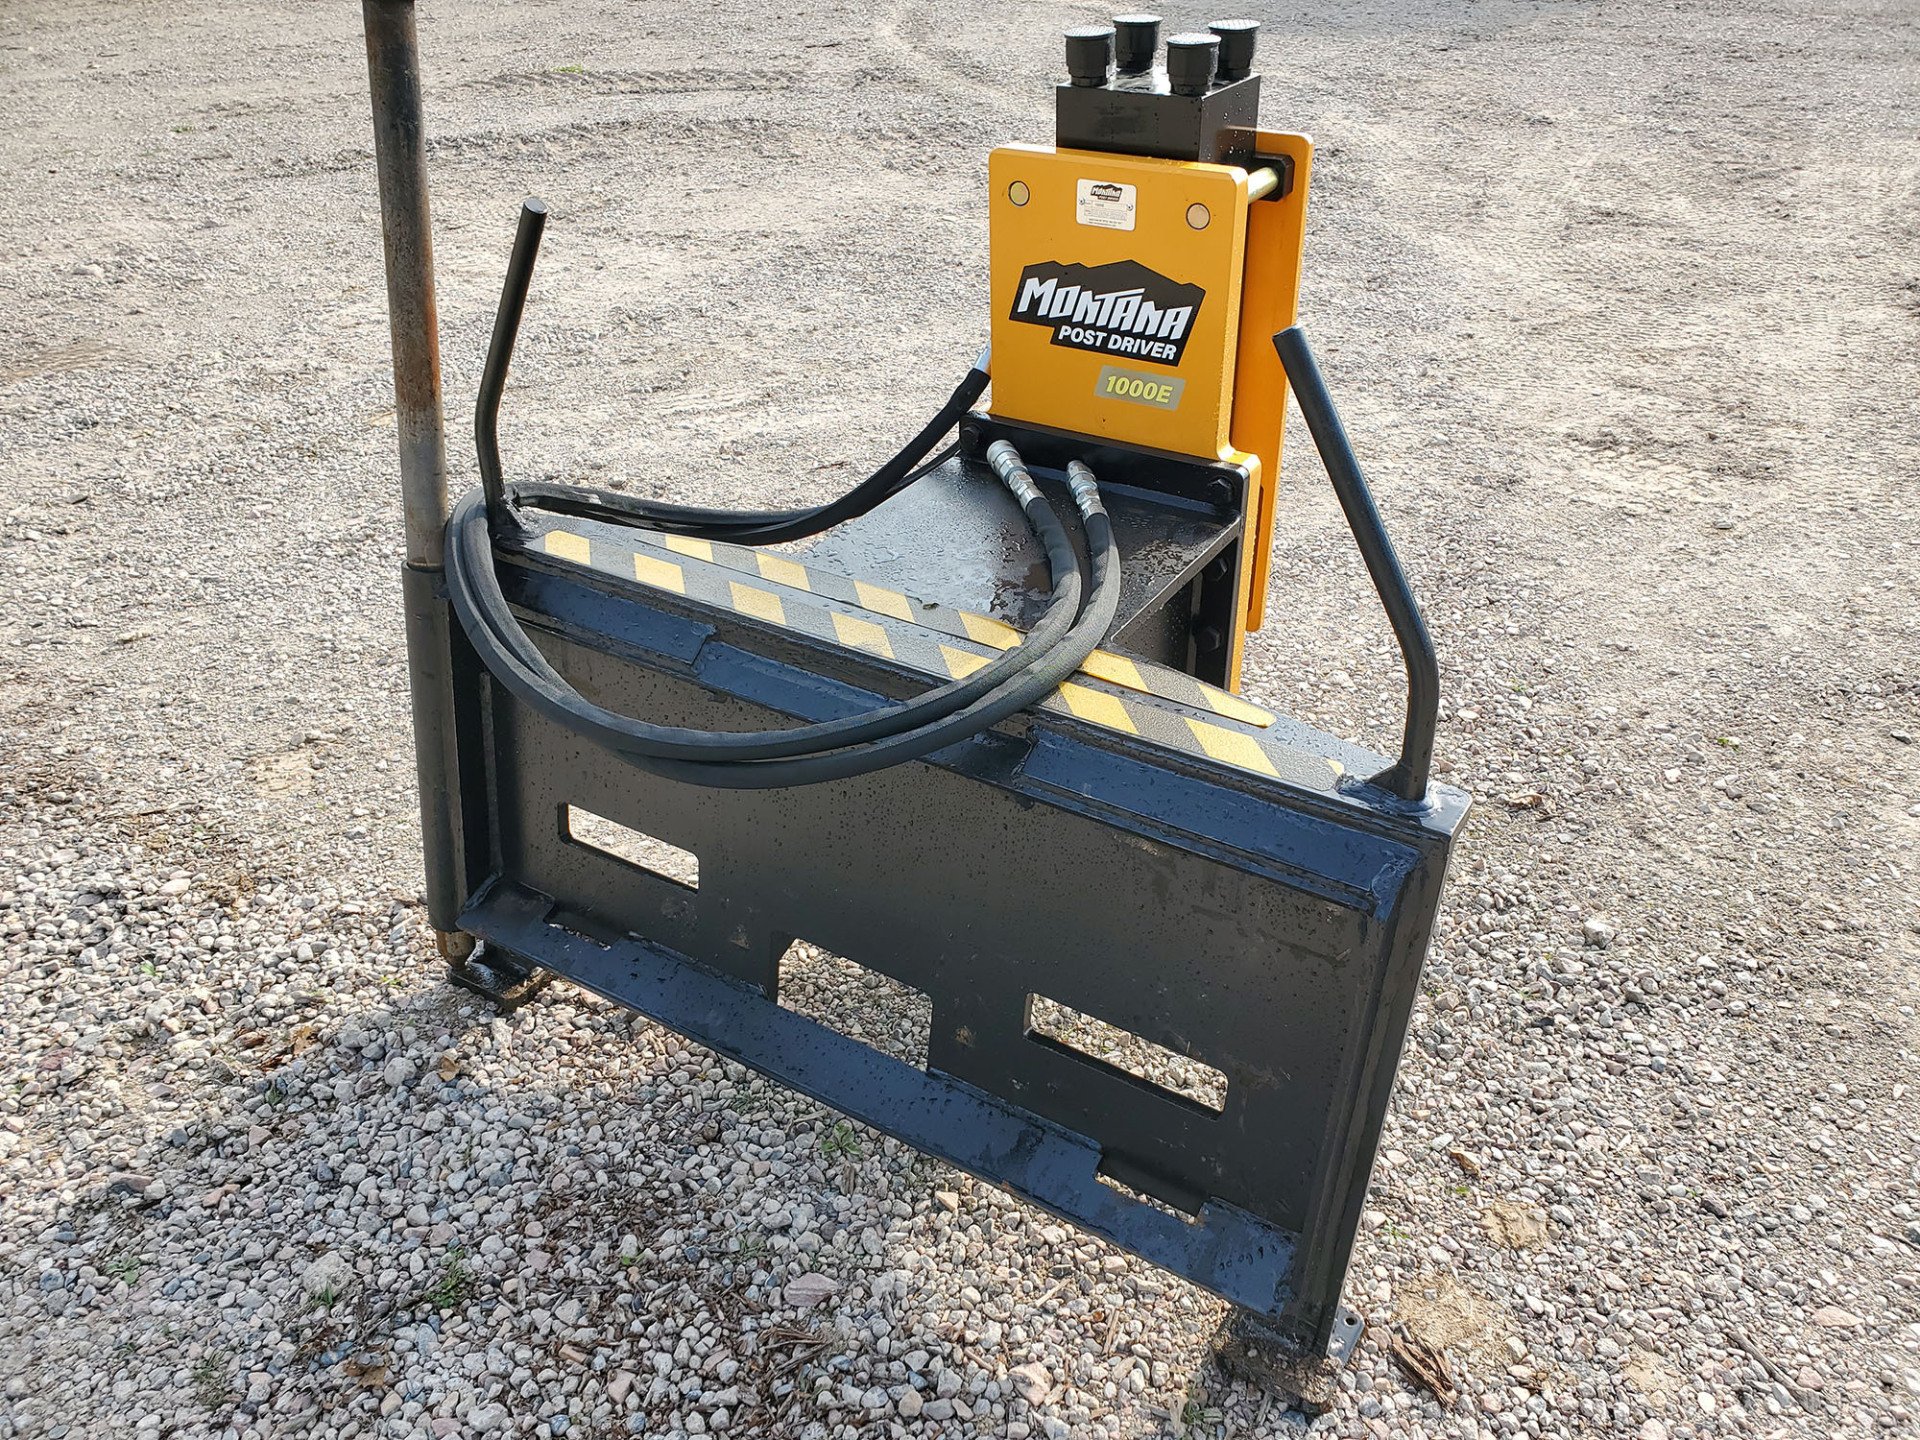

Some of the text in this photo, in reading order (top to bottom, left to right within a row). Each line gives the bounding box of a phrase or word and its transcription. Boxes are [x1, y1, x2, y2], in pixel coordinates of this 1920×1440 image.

[1017, 277, 1193, 340] MONTANA
[1058, 325, 1177, 360] POST DRIVER
[1106, 375, 1173, 403] 1000E
